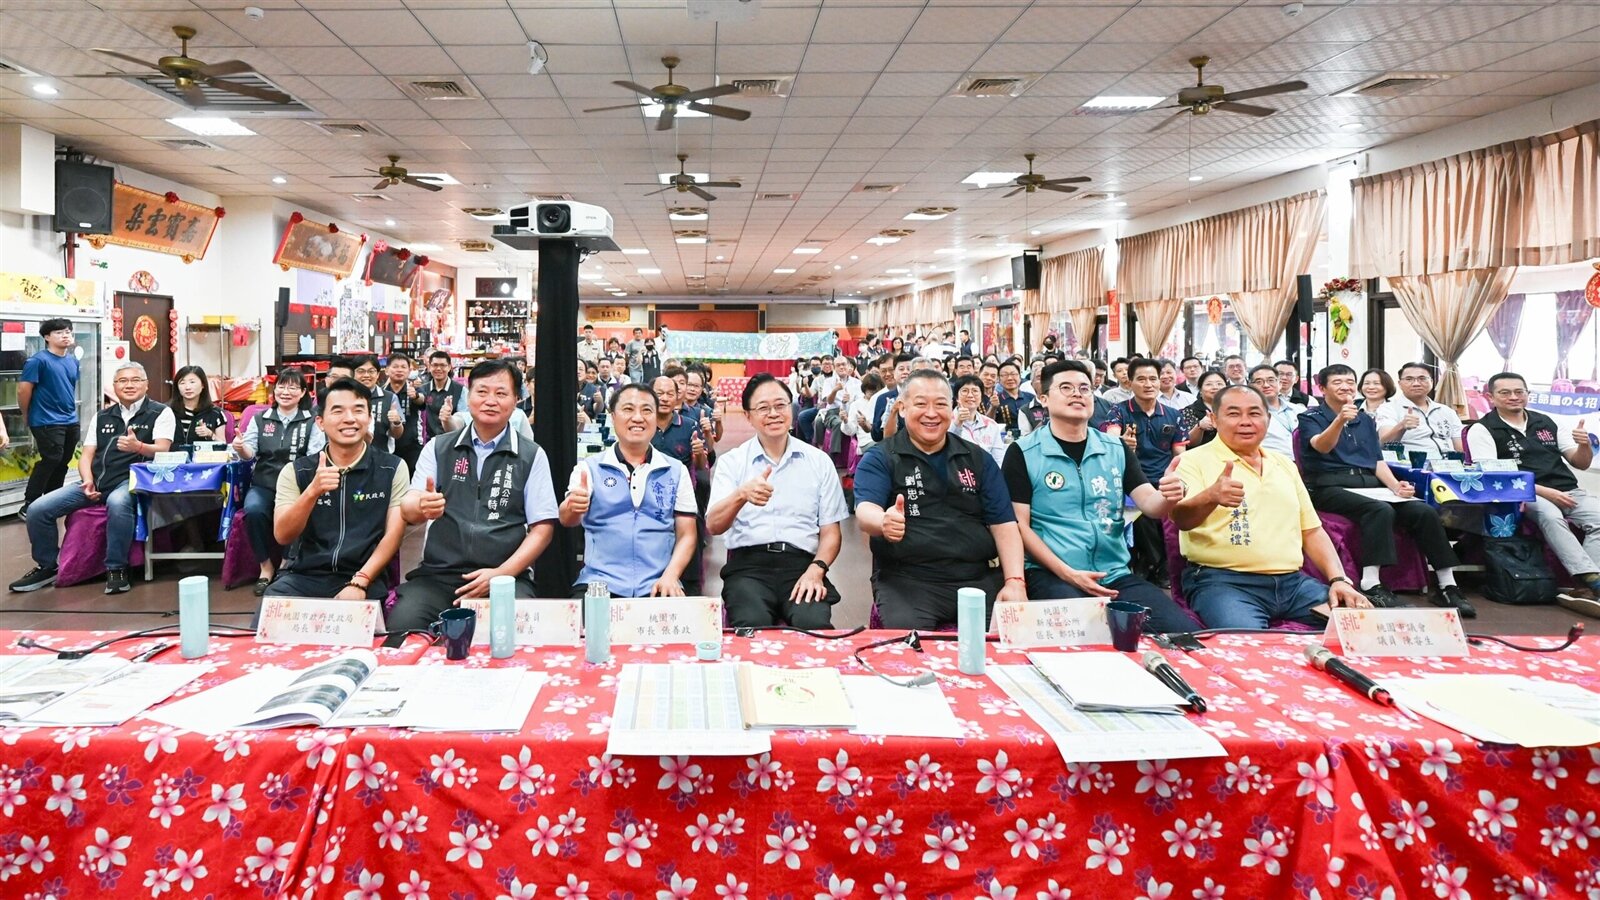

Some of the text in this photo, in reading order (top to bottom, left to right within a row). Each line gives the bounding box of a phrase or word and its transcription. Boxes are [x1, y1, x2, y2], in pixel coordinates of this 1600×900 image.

[649, 612, 678, 623] 桃園市
[637, 625, 691, 636] 市長 張善政
[1376, 622, 1426, 633] 桃園市議會
[1377, 635, 1397, 646] 議員
